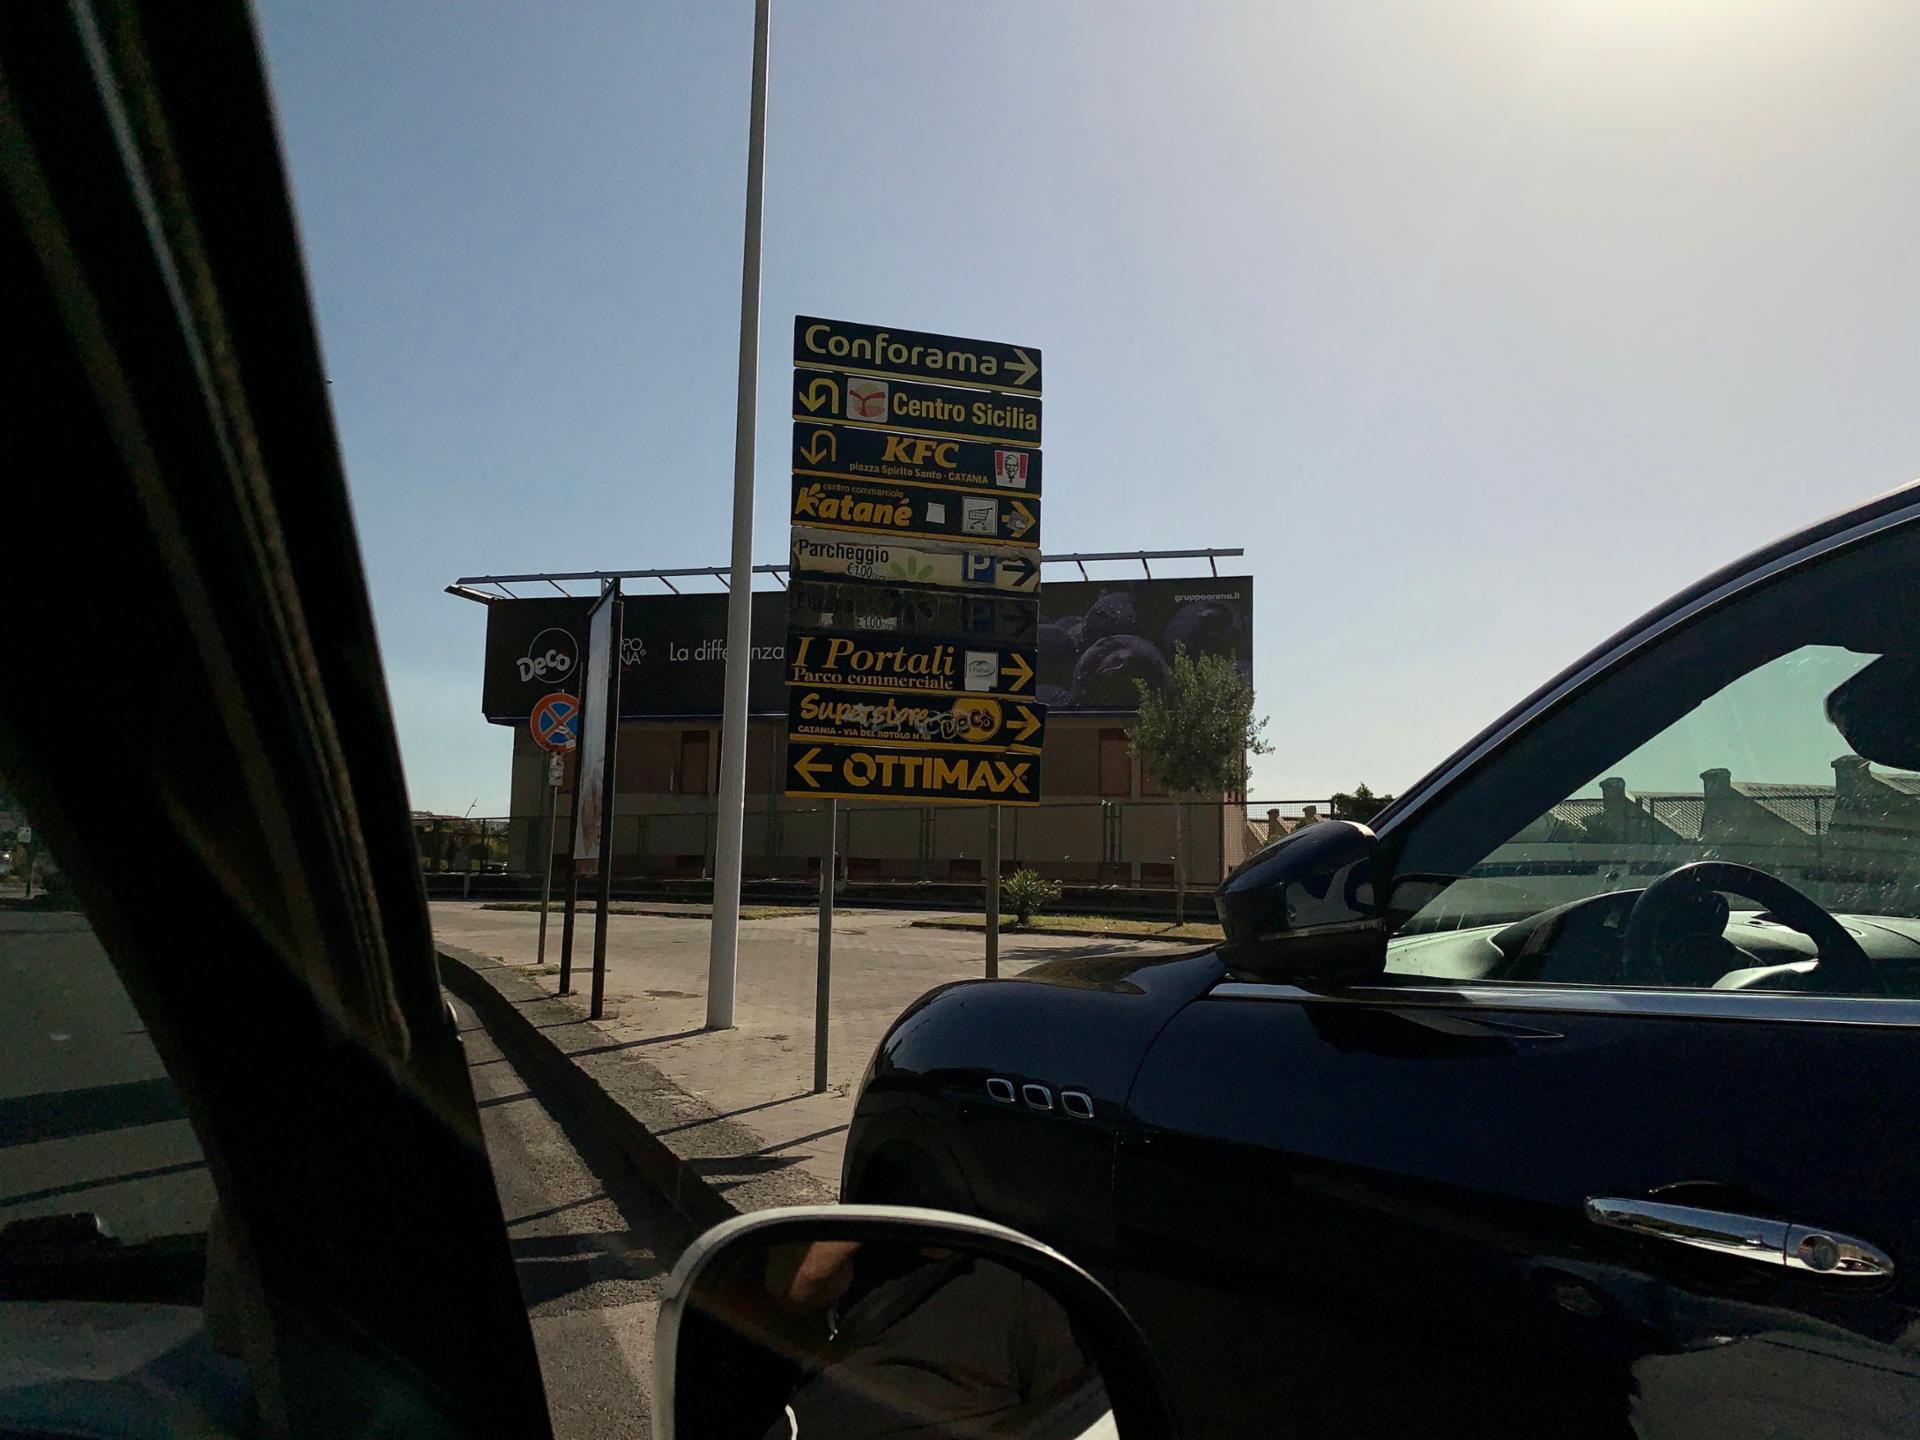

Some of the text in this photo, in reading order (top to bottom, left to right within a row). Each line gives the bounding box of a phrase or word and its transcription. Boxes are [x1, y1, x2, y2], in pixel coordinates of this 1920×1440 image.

[804, 323, 998, 376] Conforama
[891, 391, 1038, 431] Centro Sicilia
[881, 435, 960, 469] KFC
[849, 461, 880, 474] piazza
[881, 464, 914, 477] Spirito
[914, 468, 942, 480] Santo
[948, 471, 989, 485] CATANIA
[822, 482, 904, 498] centro commerciale
[794, 481, 913, 527] Katané
[798, 538, 889, 565] Parcheggio
[970, 552, 989, 579] P
[1175, 592, 1241, 602] gruppoarena.it
[669, 638, 785, 661] La diffenza
[794, 636, 957, 677] I Portali
[793, 665, 955, 690] Parco commerciale
[797, 725, 837, 735] CATANIA
[843, 727, 859, 737] VIA
[842, 751, 1031, 794] OTTIMAX
